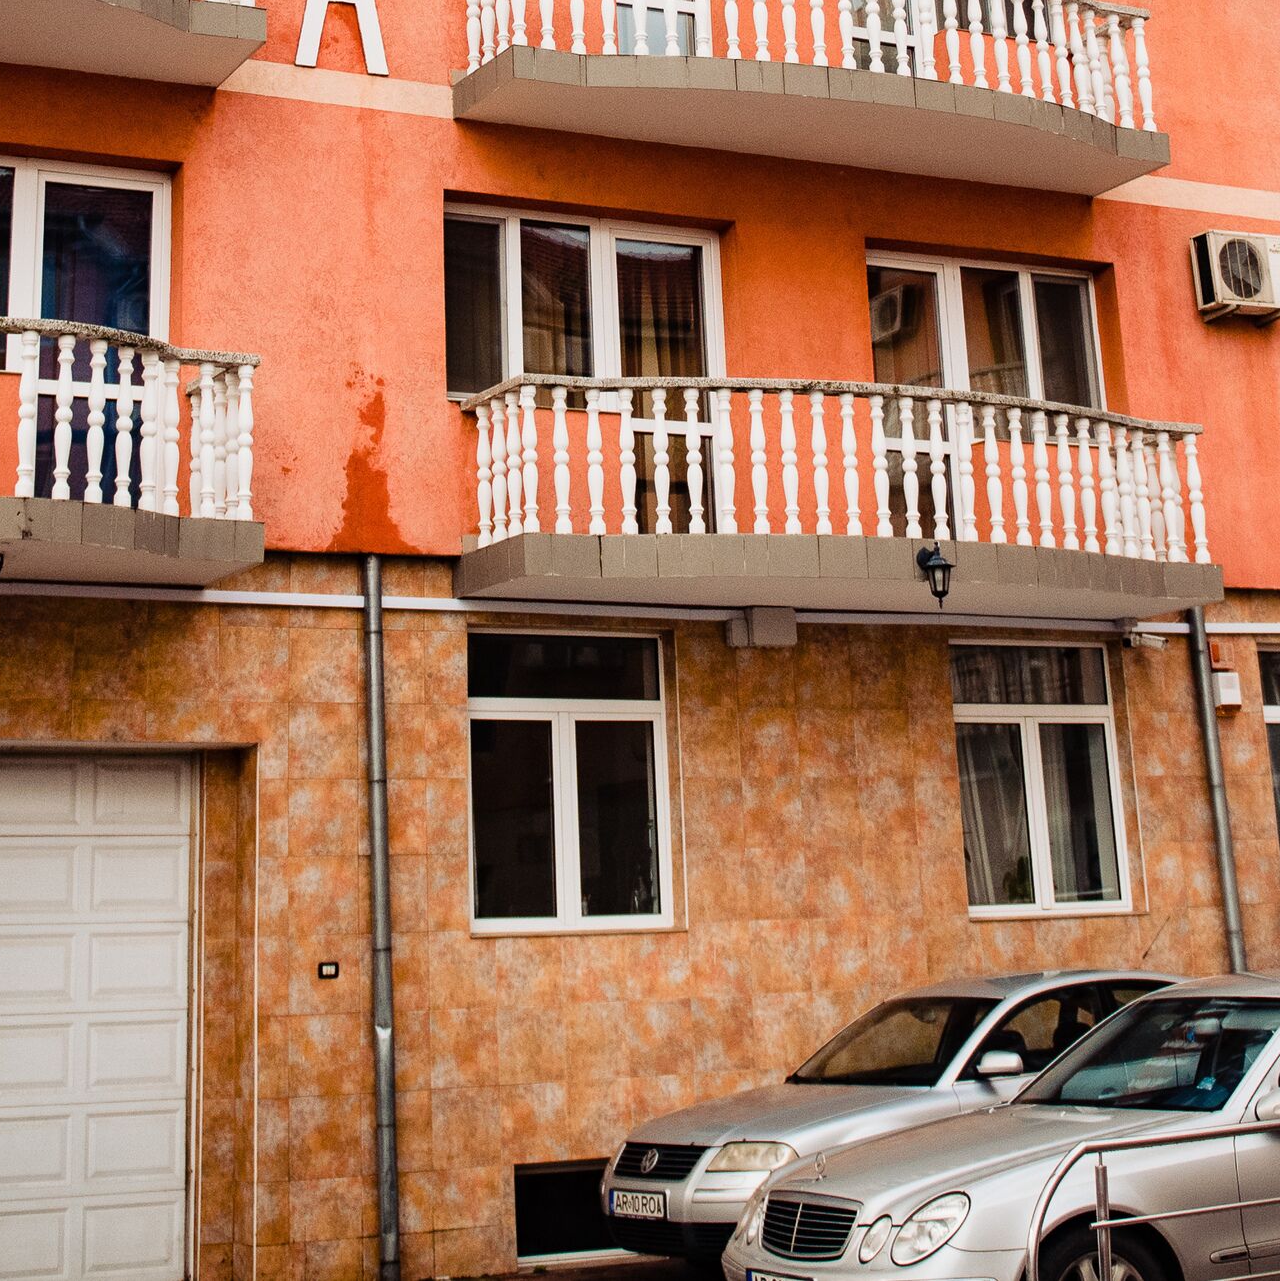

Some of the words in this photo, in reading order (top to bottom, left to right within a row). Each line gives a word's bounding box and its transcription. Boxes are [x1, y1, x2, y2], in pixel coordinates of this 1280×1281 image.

[615, 1193, 628, 1211] AR
[631, 1195, 640, 1213] 10
[641, 1196, 662, 1215] ROA
